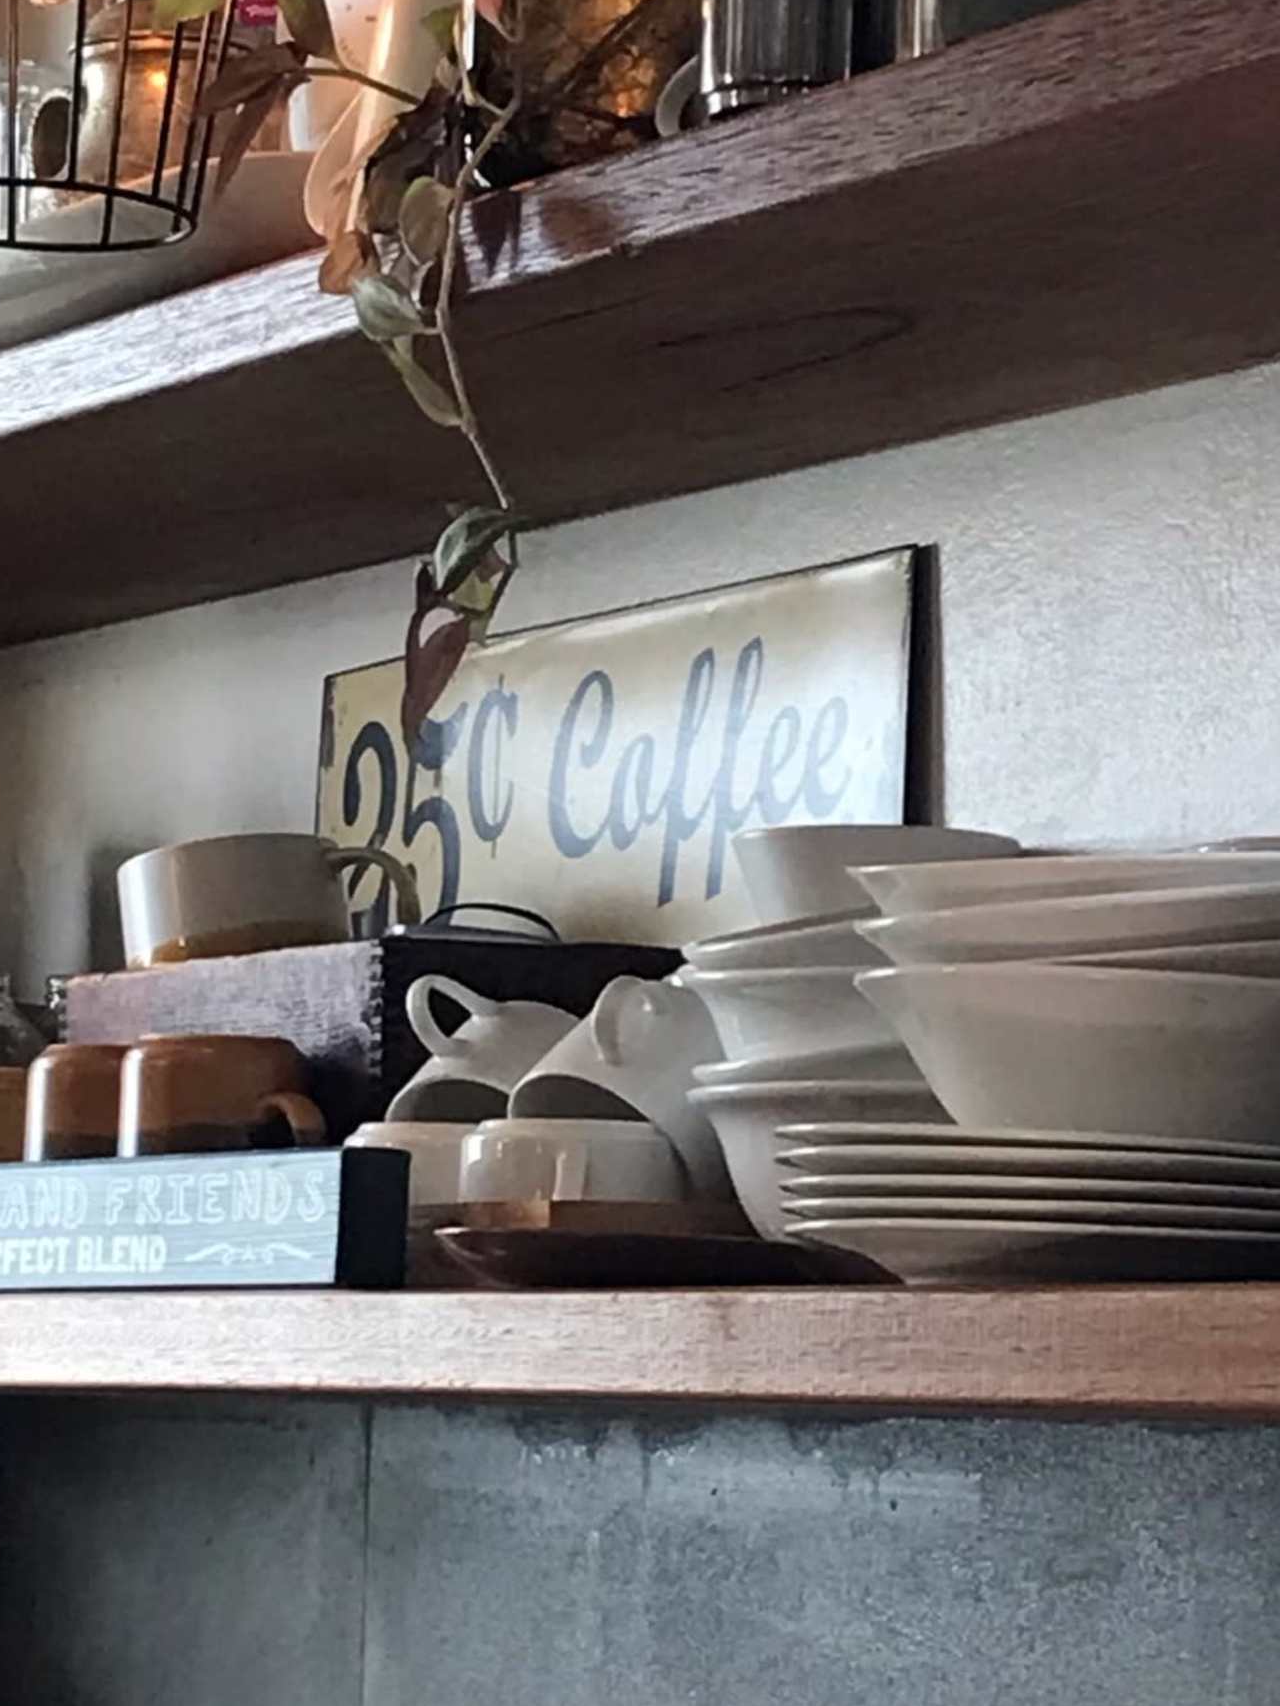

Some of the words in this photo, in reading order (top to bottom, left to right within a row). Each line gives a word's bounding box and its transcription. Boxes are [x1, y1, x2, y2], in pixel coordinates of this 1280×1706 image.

[547, 636, 851, 909] Coffee
[105, 1168, 326, 1227] FRIENDS
[76, 1233, 167, 1274] BLEND
